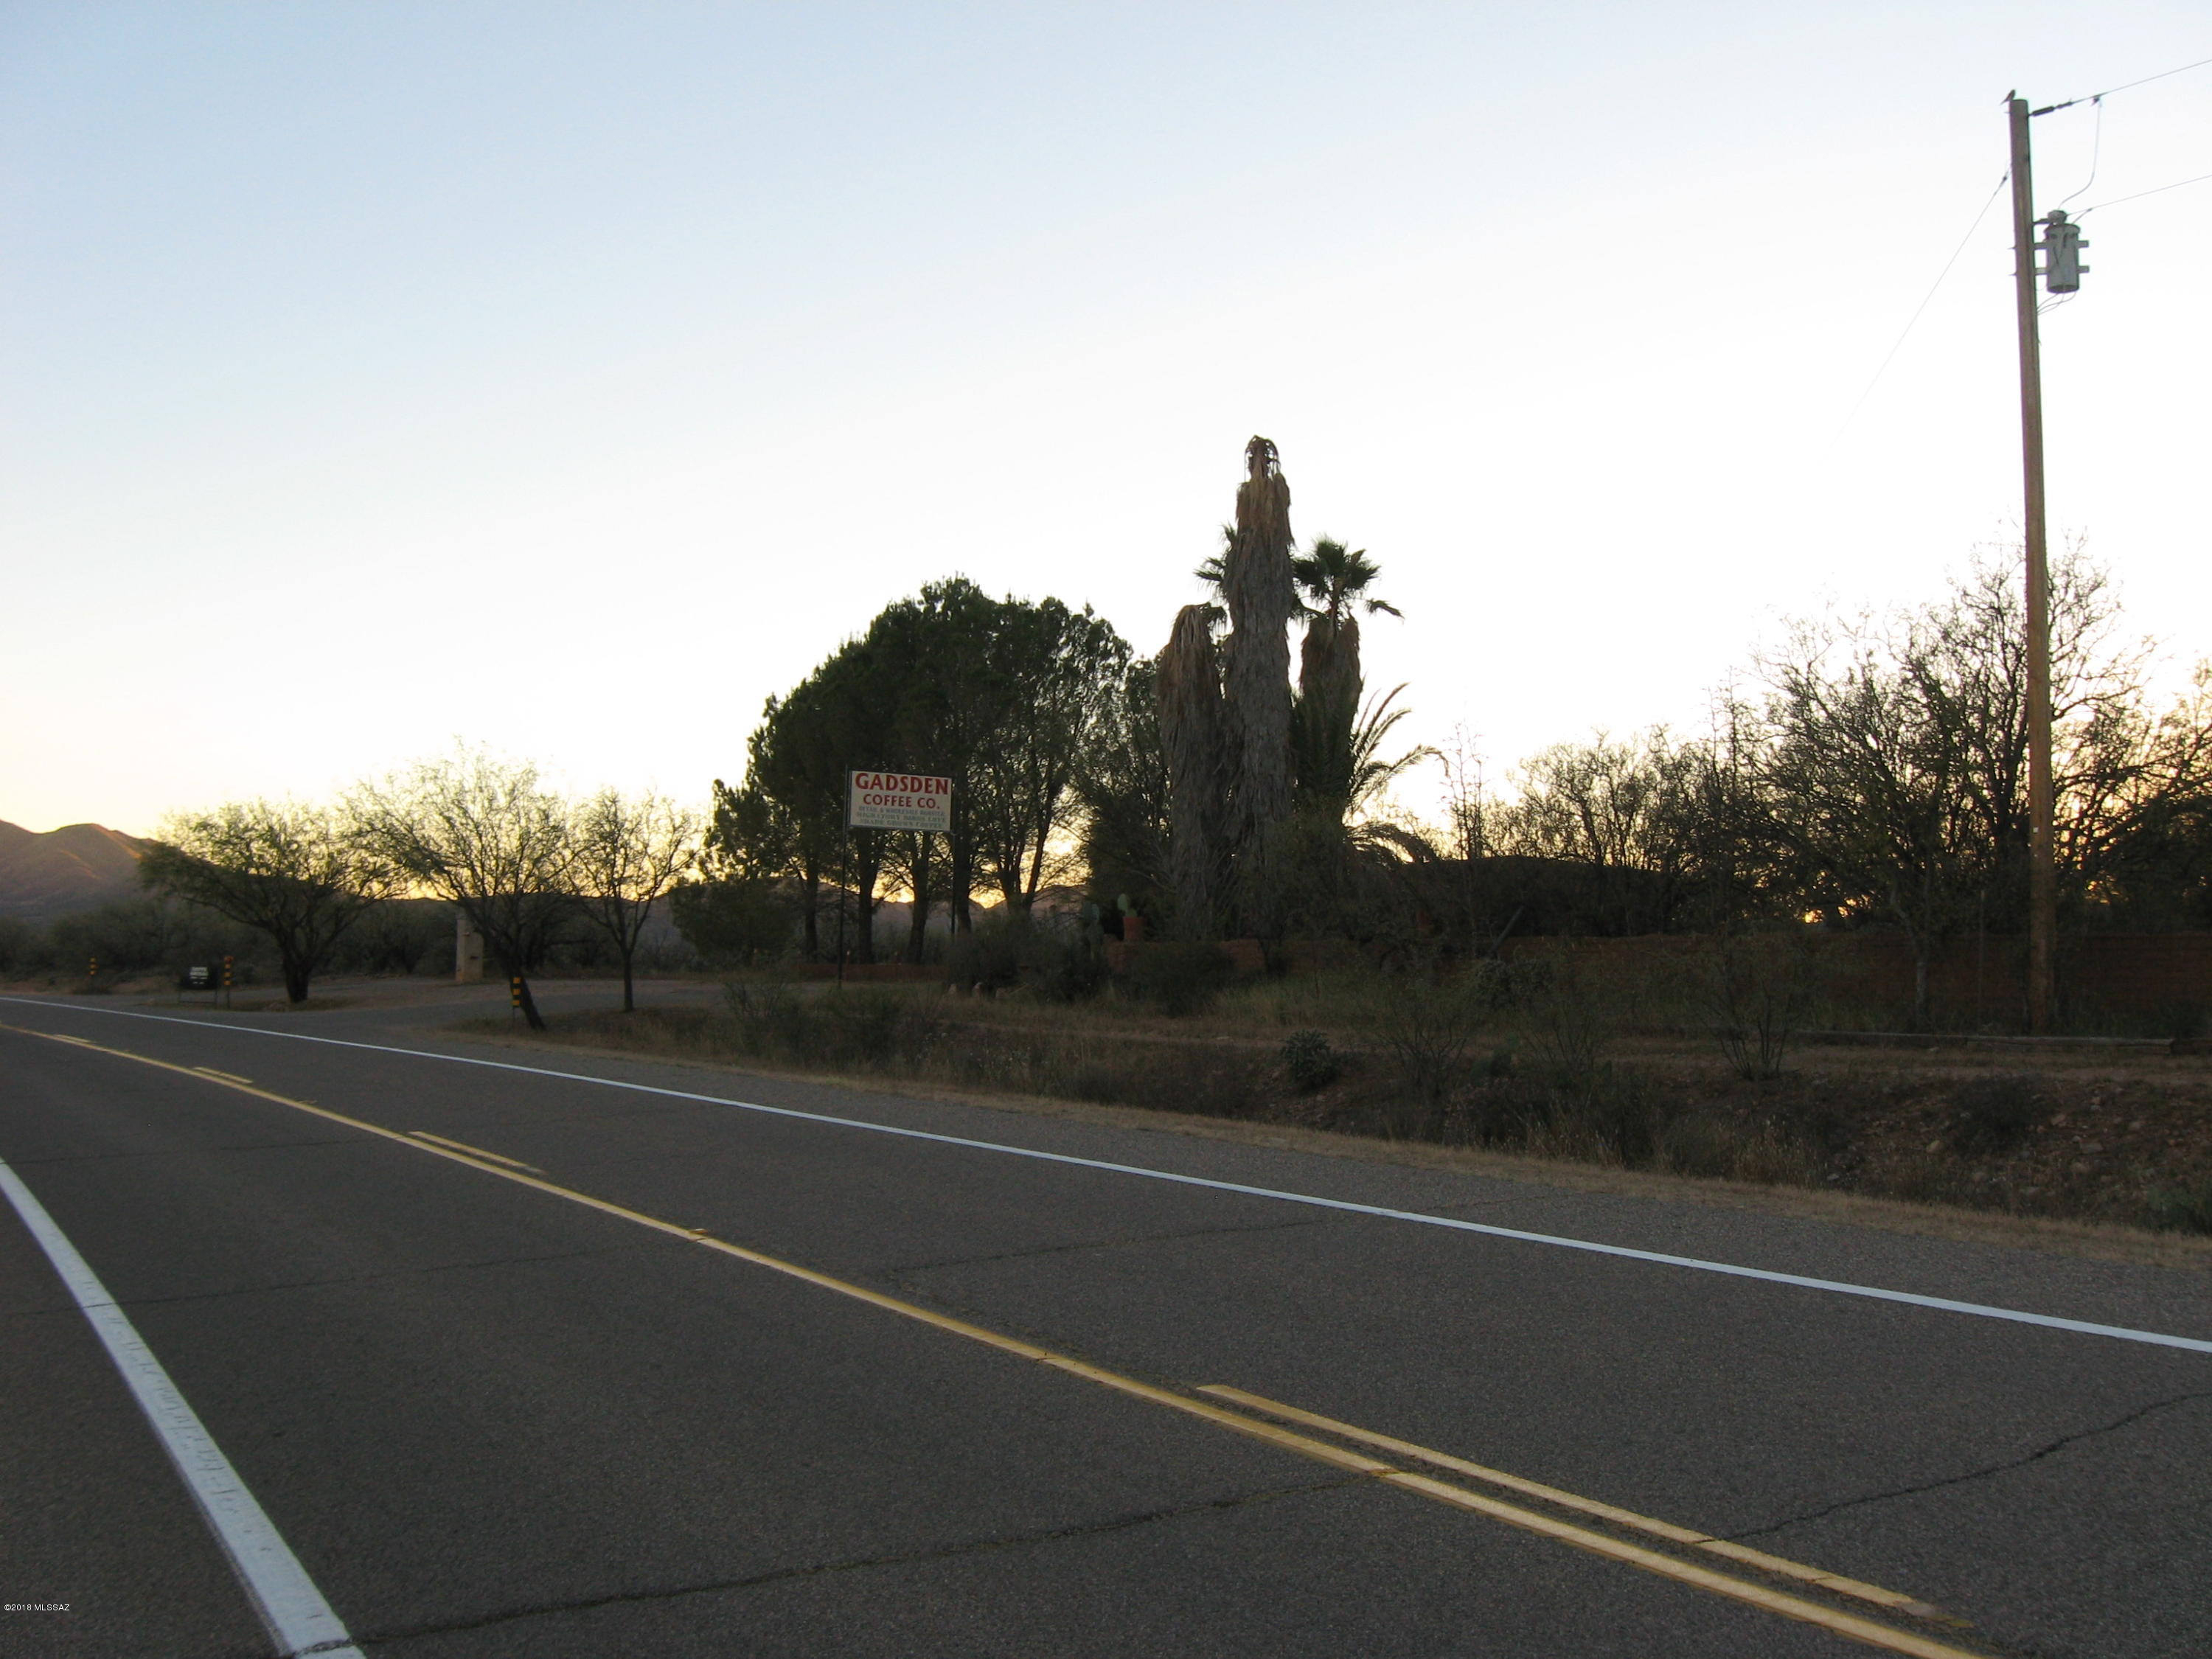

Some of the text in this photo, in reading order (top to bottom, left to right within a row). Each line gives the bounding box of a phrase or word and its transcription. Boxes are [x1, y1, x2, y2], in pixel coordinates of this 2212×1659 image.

[855, 773, 948, 795] GADSDEN
[863, 794, 940, 810] COFFEE CO.
